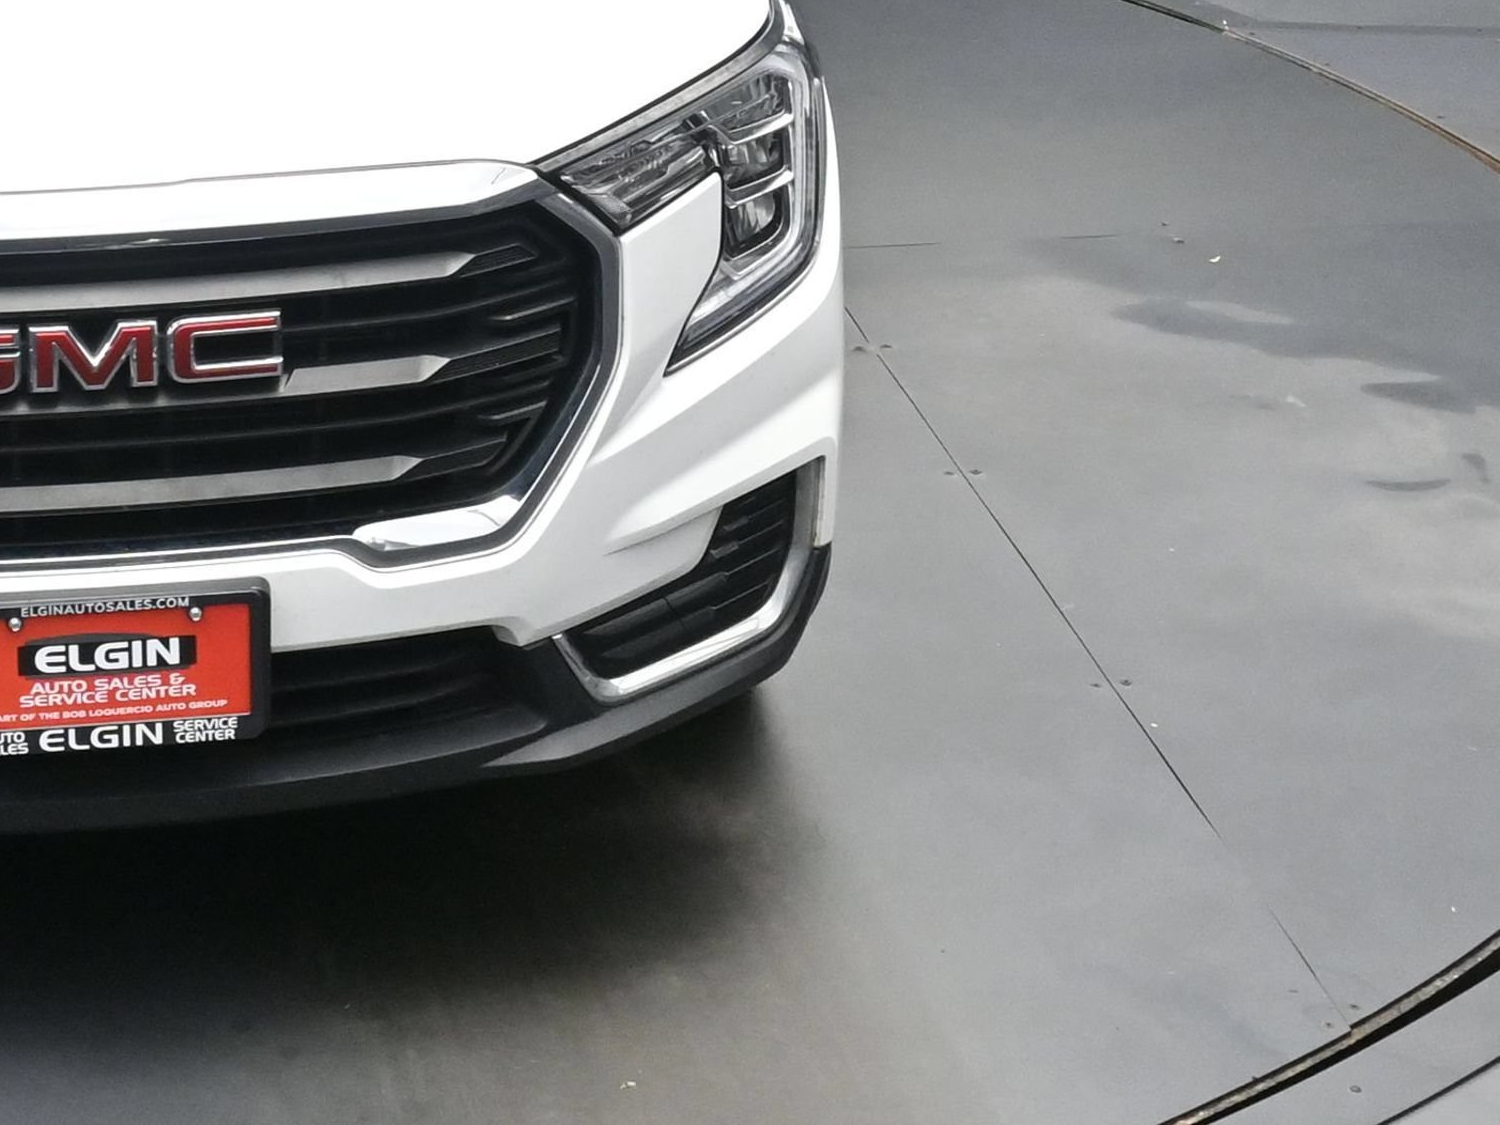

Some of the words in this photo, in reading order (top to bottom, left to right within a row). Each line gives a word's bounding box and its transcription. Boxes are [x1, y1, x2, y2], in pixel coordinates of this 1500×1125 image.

[20, 596, 190, 618] ELGINAUTOSALES.COM
[34, 637, 181, 673] ELGIN
[30, 678, 88, 695] AUTO
[93, 674, 162, 691] SALES
[169, 672, 186, 686] &
[19, 690, 109, 708] SERVICE
[115, 684, 197, 702] CENTER
[19, 713, 37, 722] OF
[38, 711, 61, 721] THE
[62, 709, 86, 719] BOB
[88, 705, 153, 718] LOQUERCIO
[155, 702, 187, 712] AUTO
[188, 699, 229, 710] GROUP
[173, 716, 239, 733] SERVICE
[175, 728, 236, 744] CENTER
[38, 722, 164, 752] ELGIN
